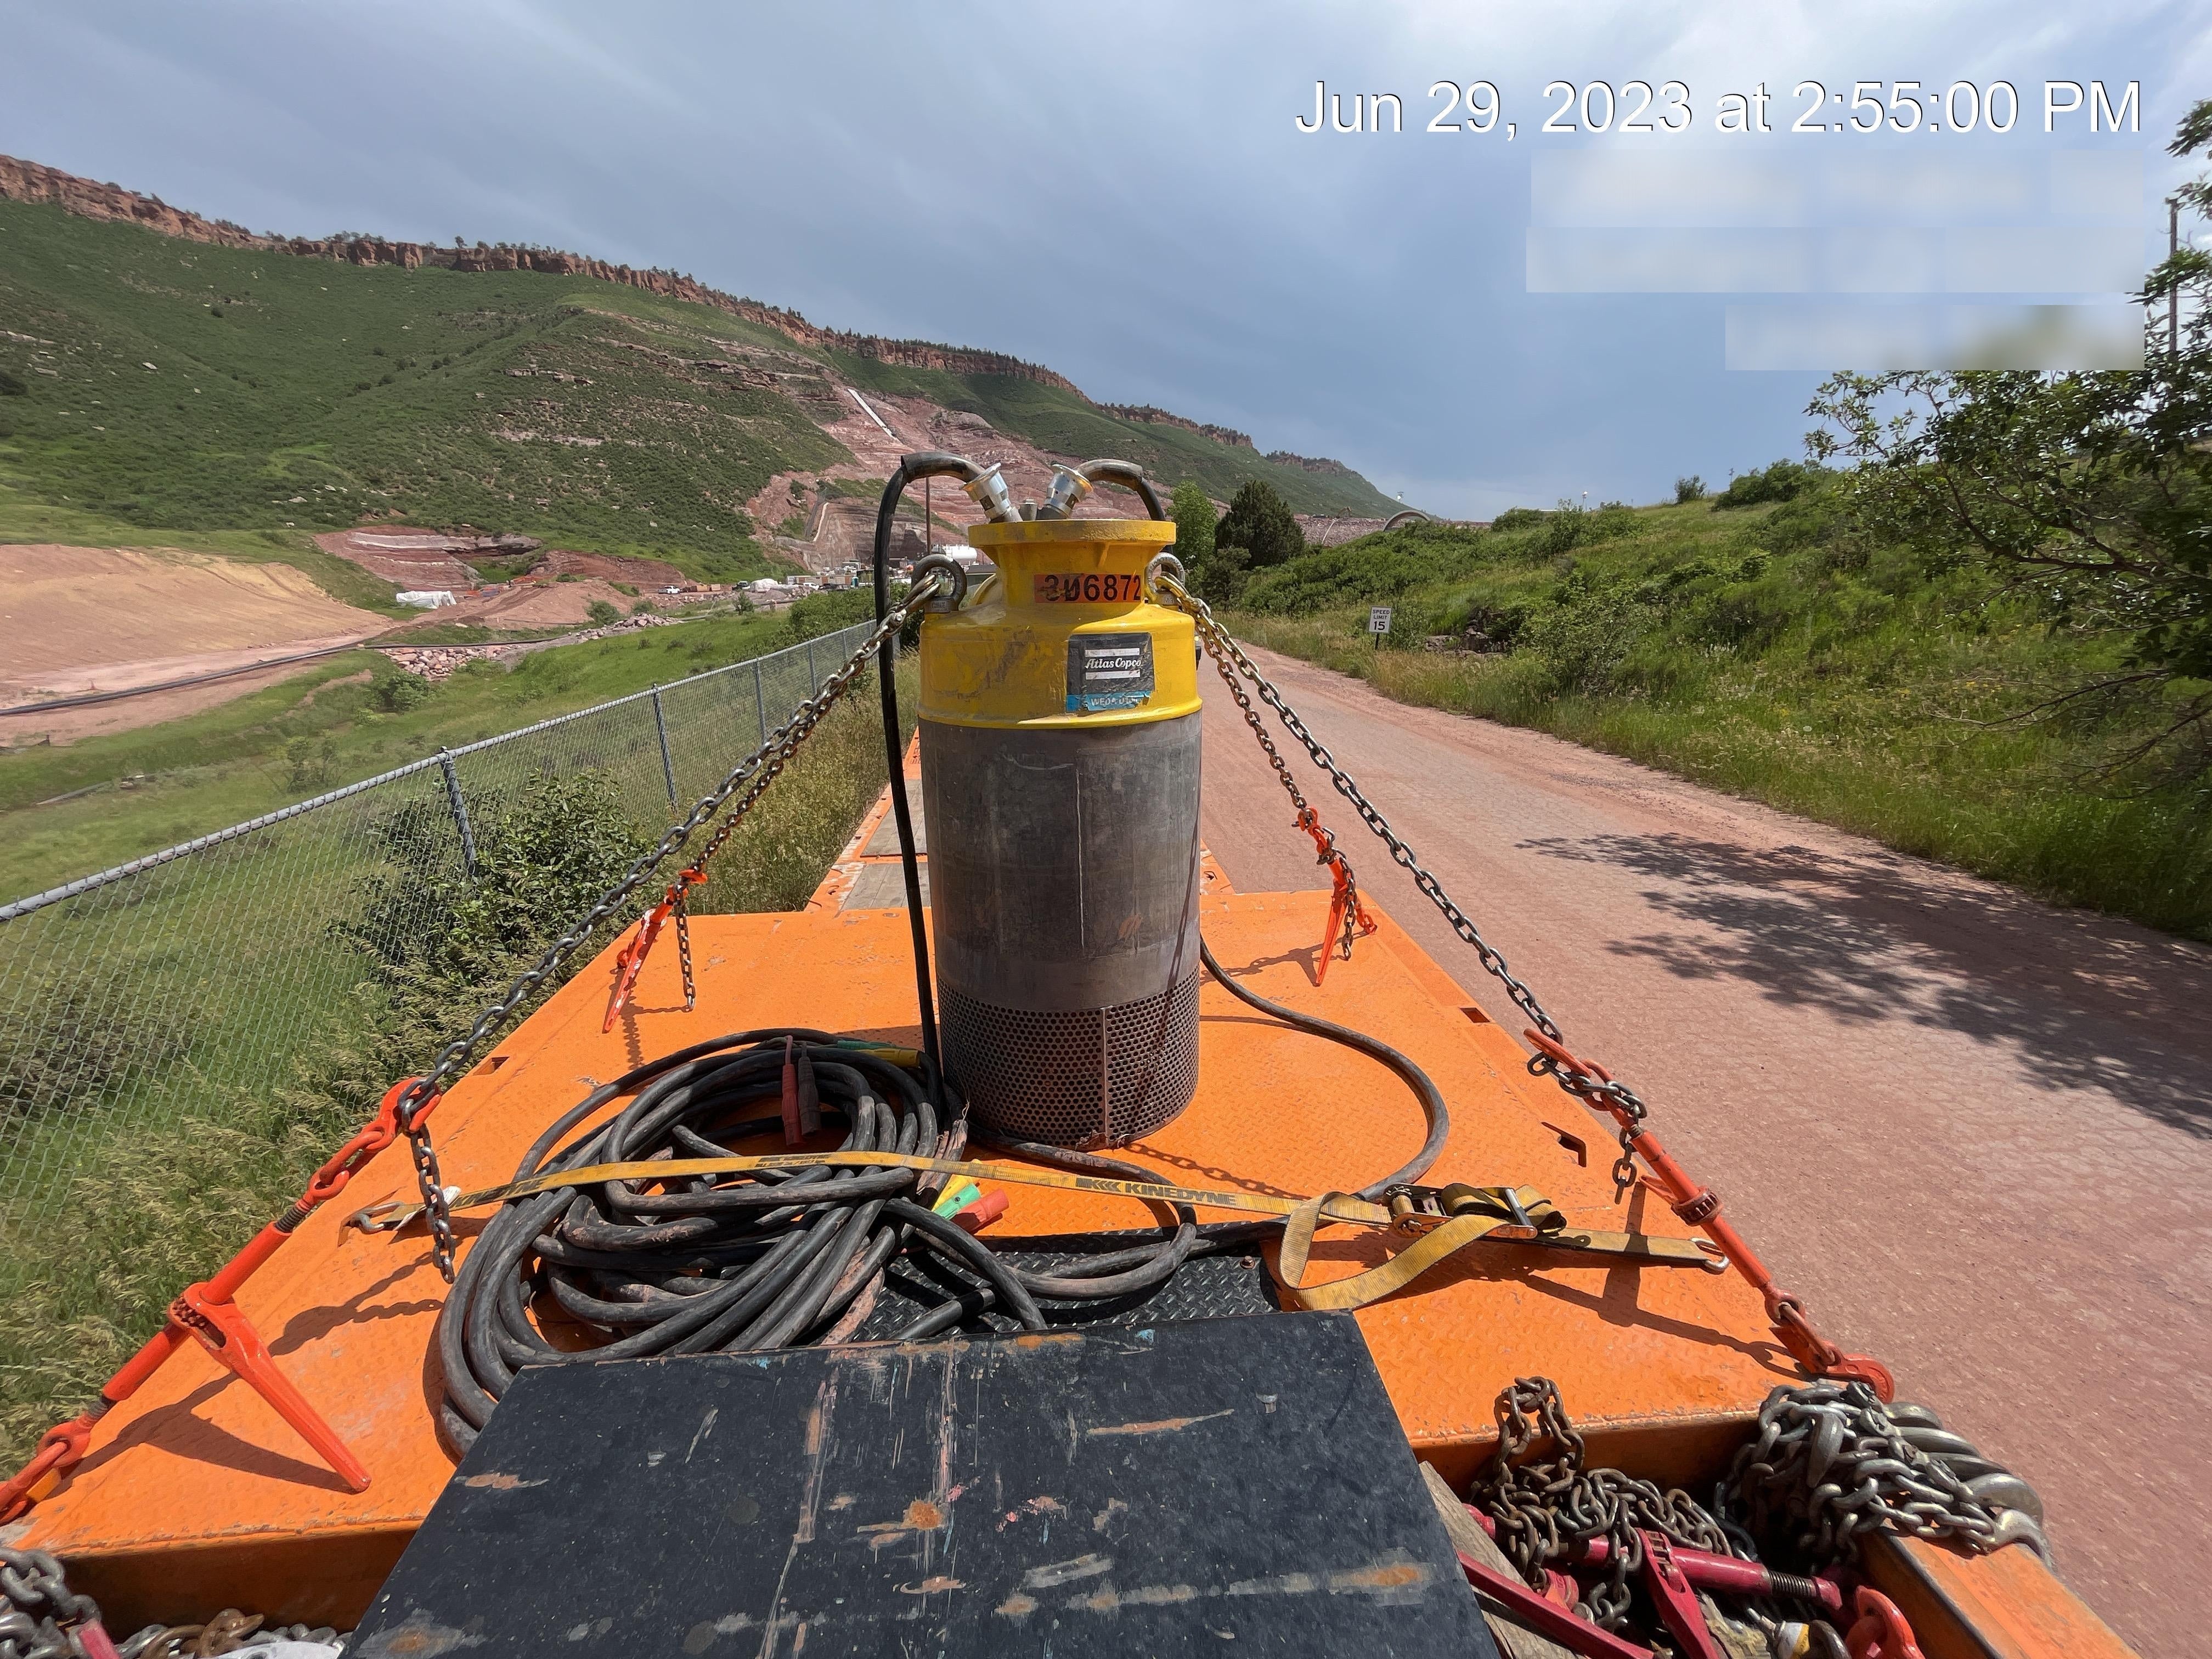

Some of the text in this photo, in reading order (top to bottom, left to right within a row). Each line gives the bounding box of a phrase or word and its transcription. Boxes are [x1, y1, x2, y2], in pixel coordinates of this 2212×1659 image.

[1374, 621, 1385, 630] 15
[1085, 658, 1141, 669] Atlas Copco
[1125, 1182, 1238, 1205] KINEDYNE
